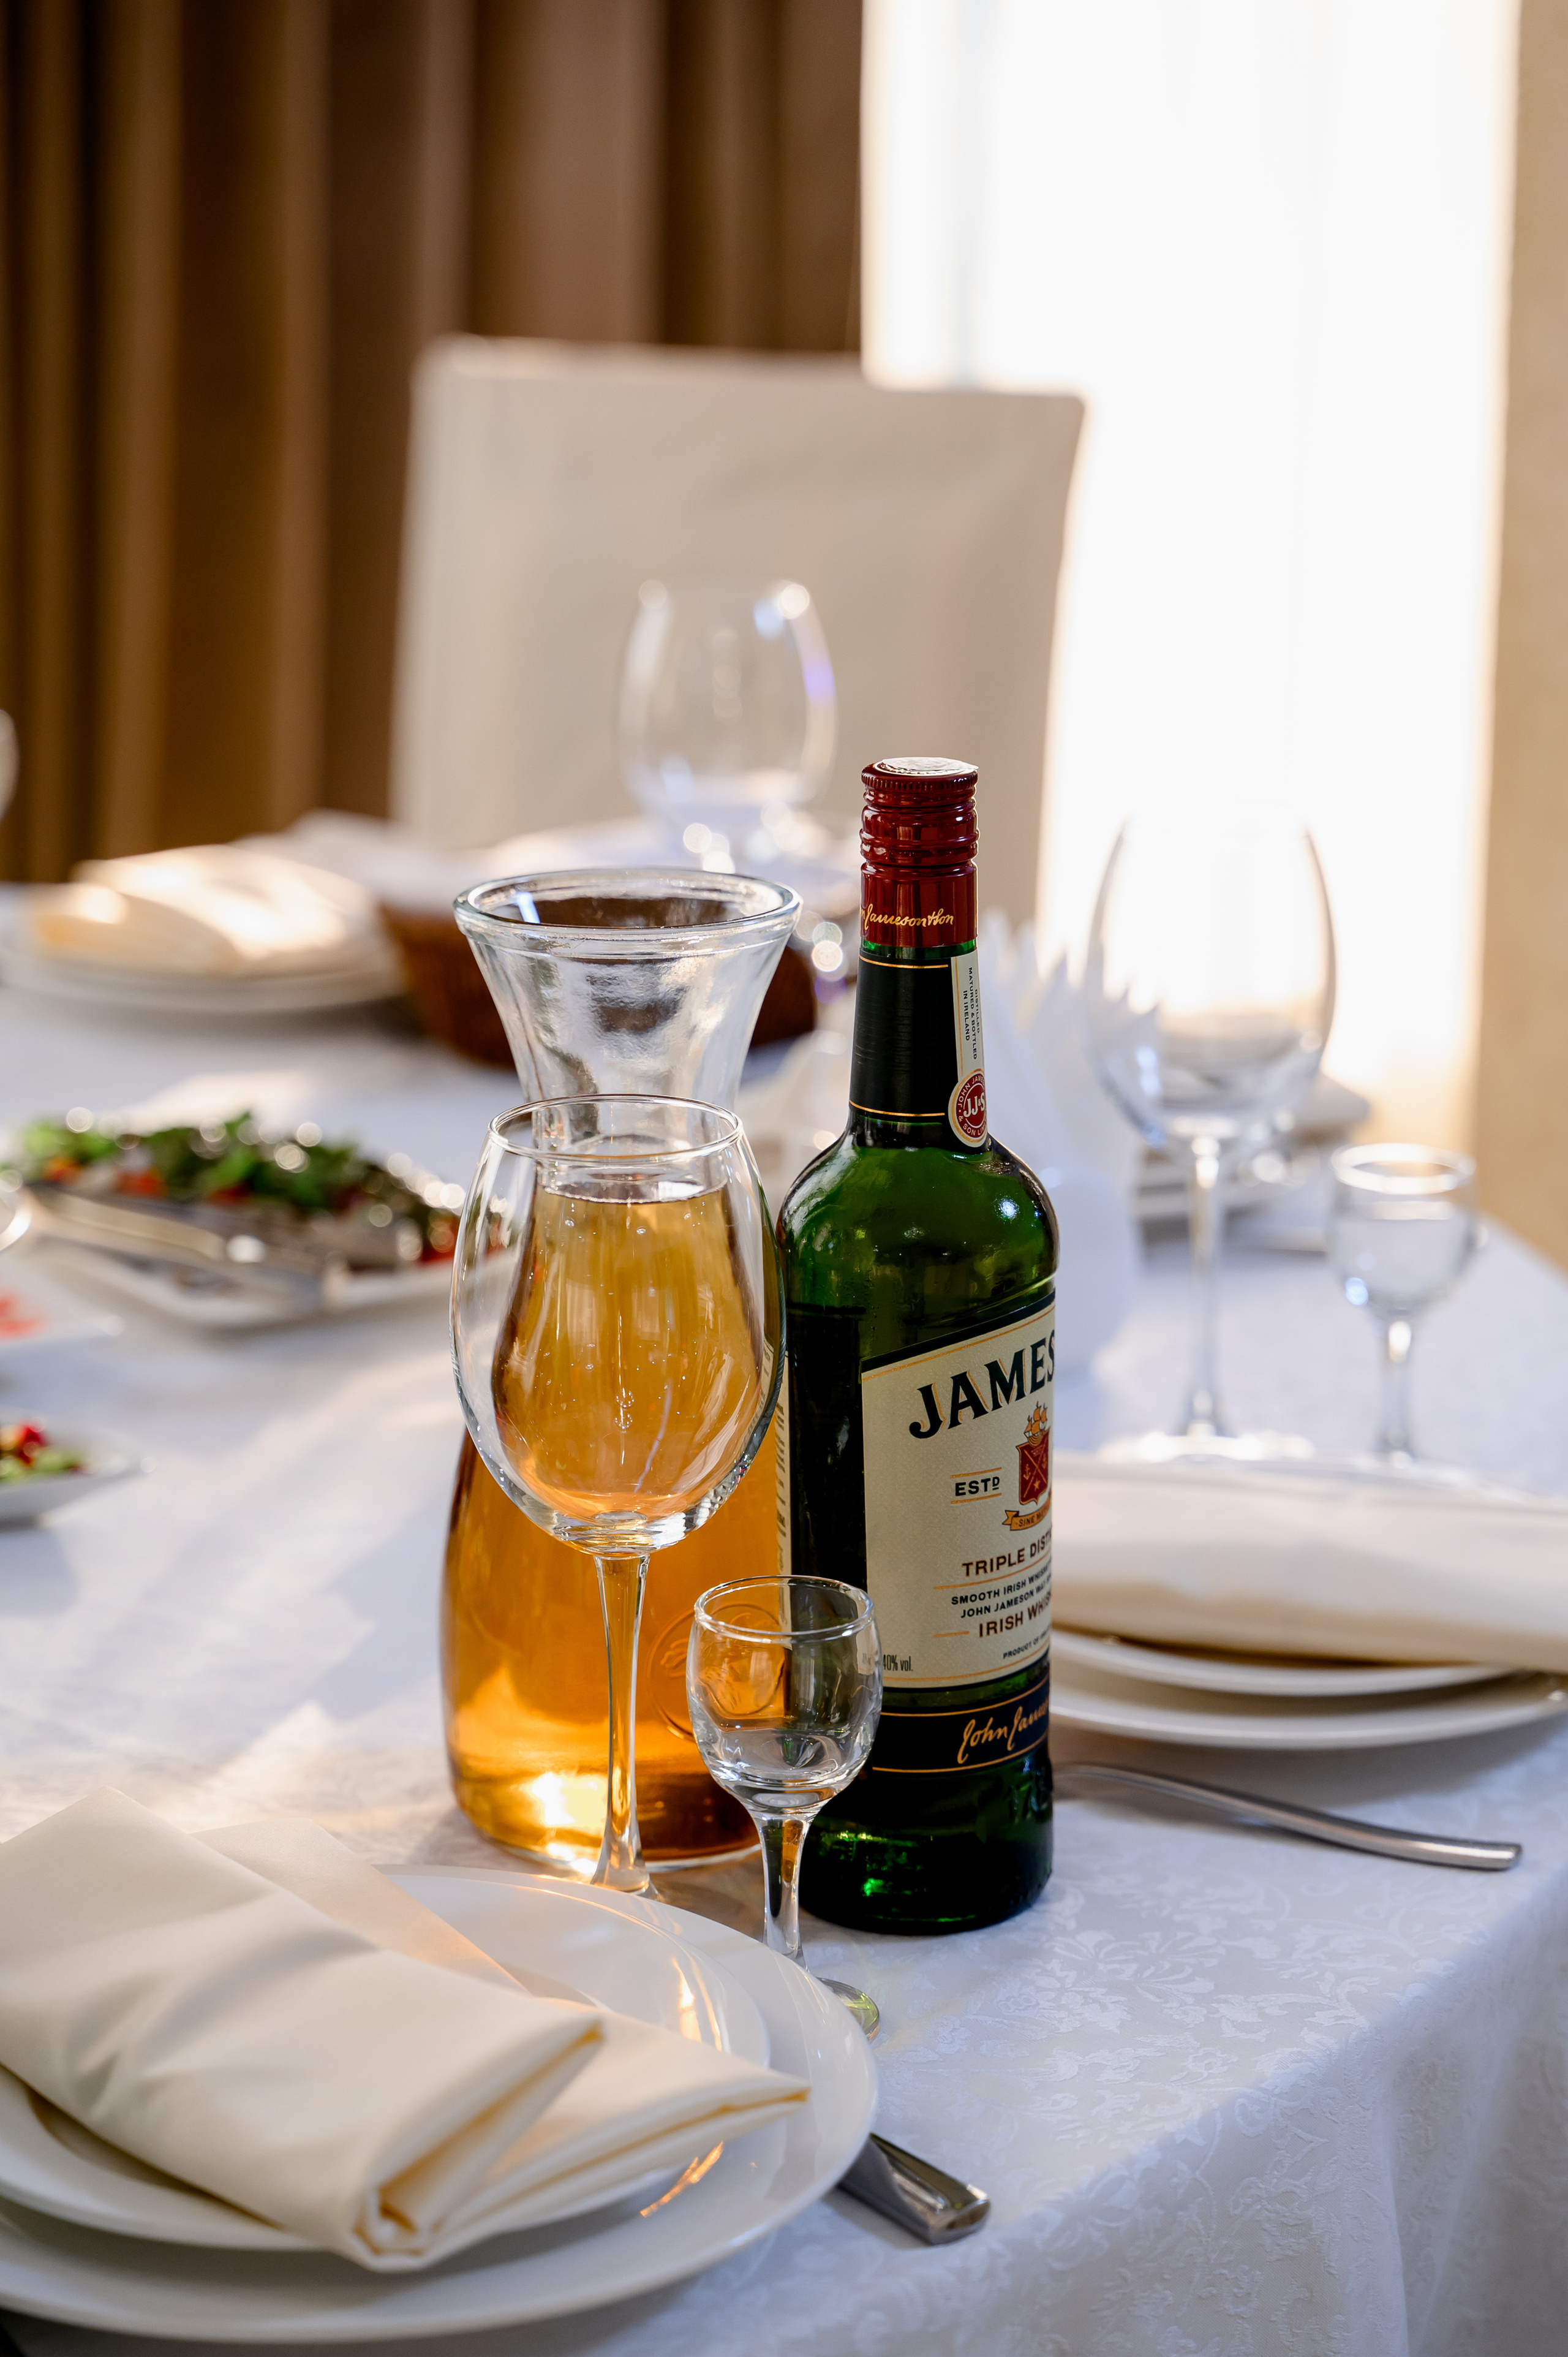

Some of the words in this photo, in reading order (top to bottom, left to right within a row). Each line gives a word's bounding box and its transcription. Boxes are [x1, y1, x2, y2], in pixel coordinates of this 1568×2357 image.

[963, 990, 968, 999] IN
[957, 1083, 971, 1108] JOHN
[963, 1092, 986, 1118] JJ&S
[963, 1123, 976, 1136] SON
[909, 1329, 1055, 1439] JAMES
[955, 1476, 1000, 1497] ESTD
[962, 1547, 1025, 1577] TRIPLE
[951, 1589, 1000, 1605] SMOOTH
[1003, 1578, 1026, 1595] IRISH
[960, 1605, 991, 1619] JOHN
[994, 1589, 1034, 1612] JAMESON
[979, 1611, 1023, 1638] IRISH
[883, 1654, 898, 1671] 40%
[900, 1655, 913, 1671] vol.
[957, 1717, 1008, 1764] John
